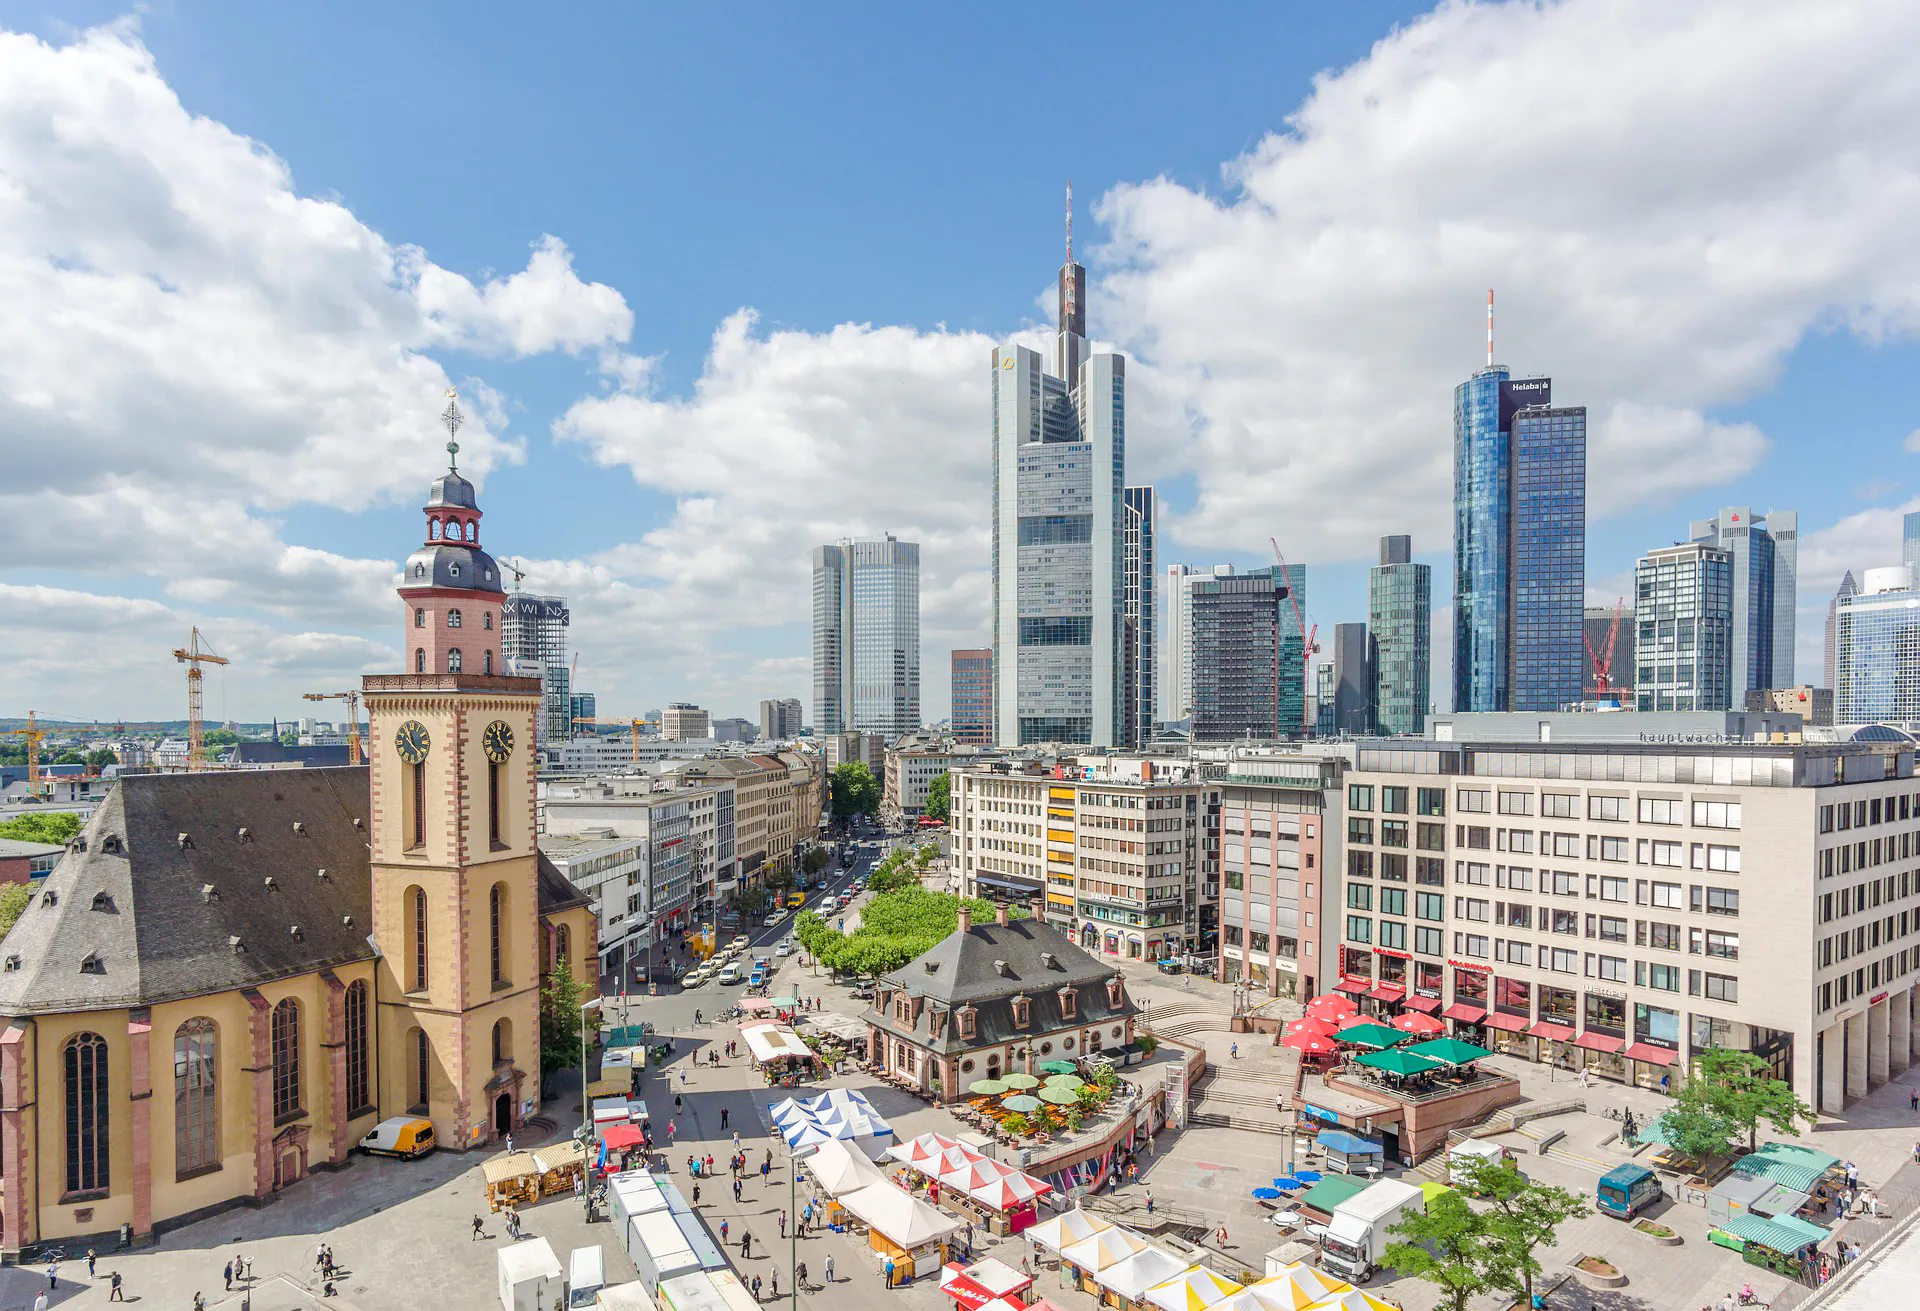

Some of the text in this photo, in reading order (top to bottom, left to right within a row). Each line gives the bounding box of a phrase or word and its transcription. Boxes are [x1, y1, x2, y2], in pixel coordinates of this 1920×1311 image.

[1513, 383, 1539, 391] Helaba
[1448, 959, 1493, 973] MAREDO
[1416, 988, 1439, 996] STARBUCKS
[1583, 984, 1626, 999] WEMPE
[1547, 1017, 1568, 1025] WEMPE
[1645, 1037, 1669, 1047] WEMPE
